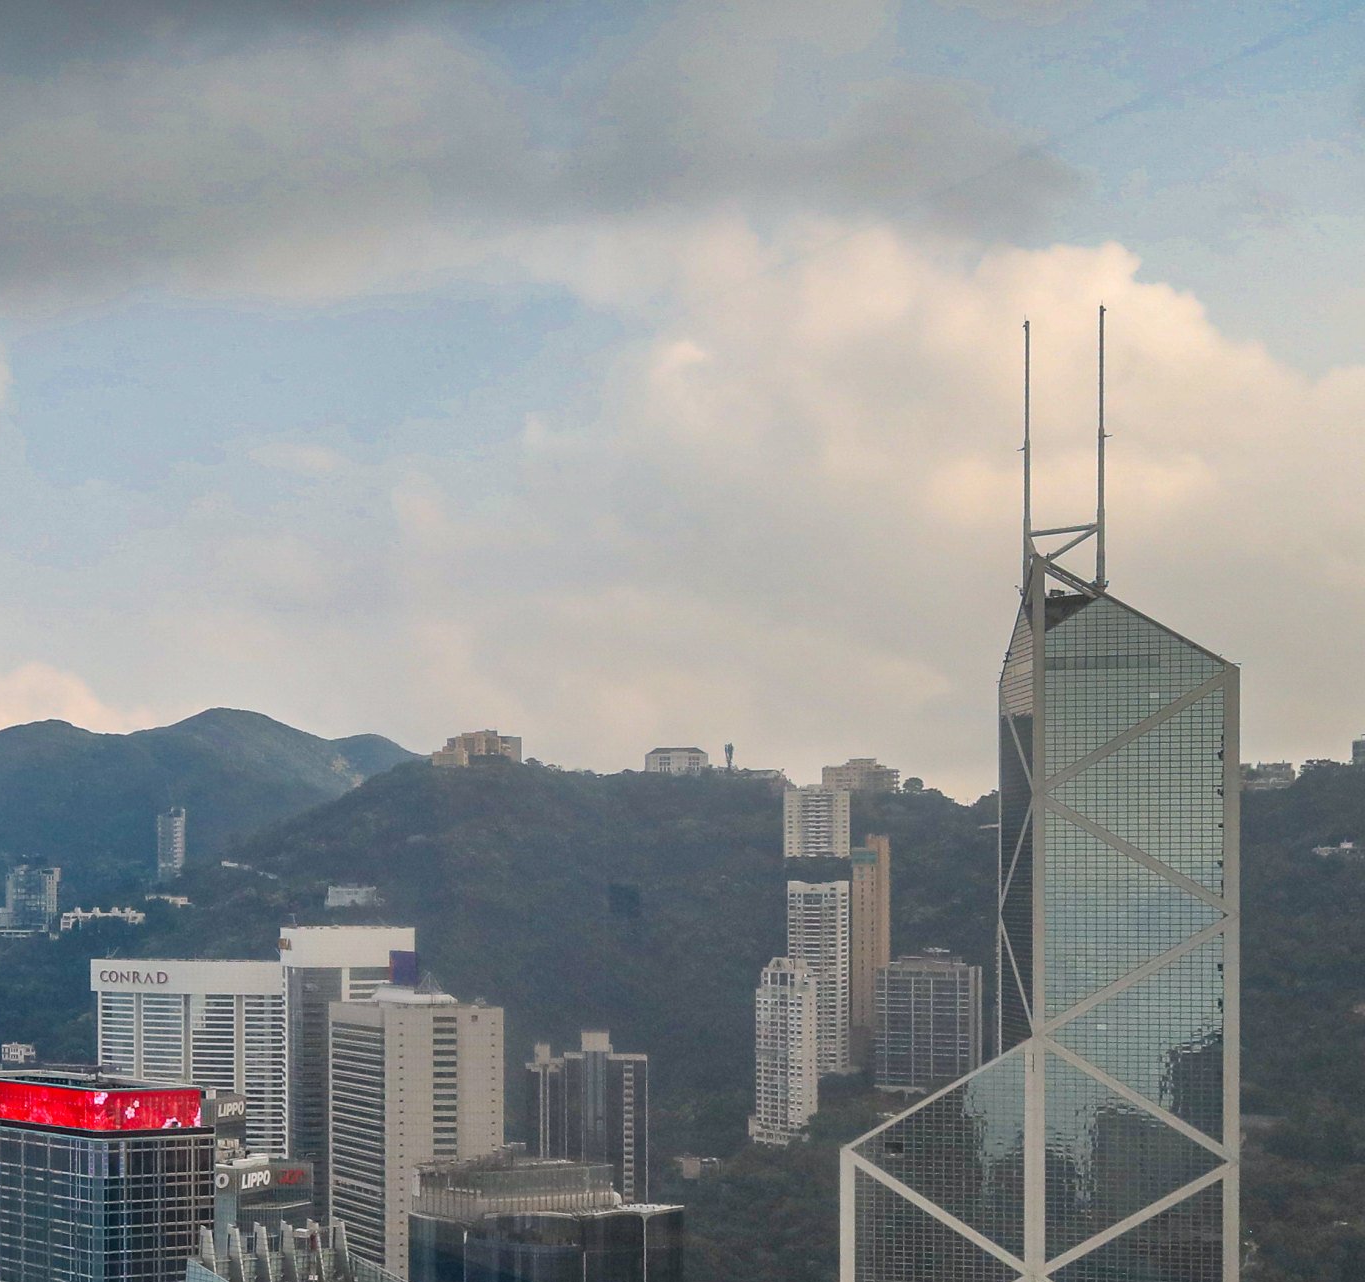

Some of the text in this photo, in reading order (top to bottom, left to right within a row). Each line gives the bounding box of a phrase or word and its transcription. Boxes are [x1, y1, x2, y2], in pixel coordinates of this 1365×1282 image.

[100, 970, 168, 984] CONRAD
[218, 1101, 245, 1118] LIPPO
[241, 1169, 271, 1190] LIPPO
